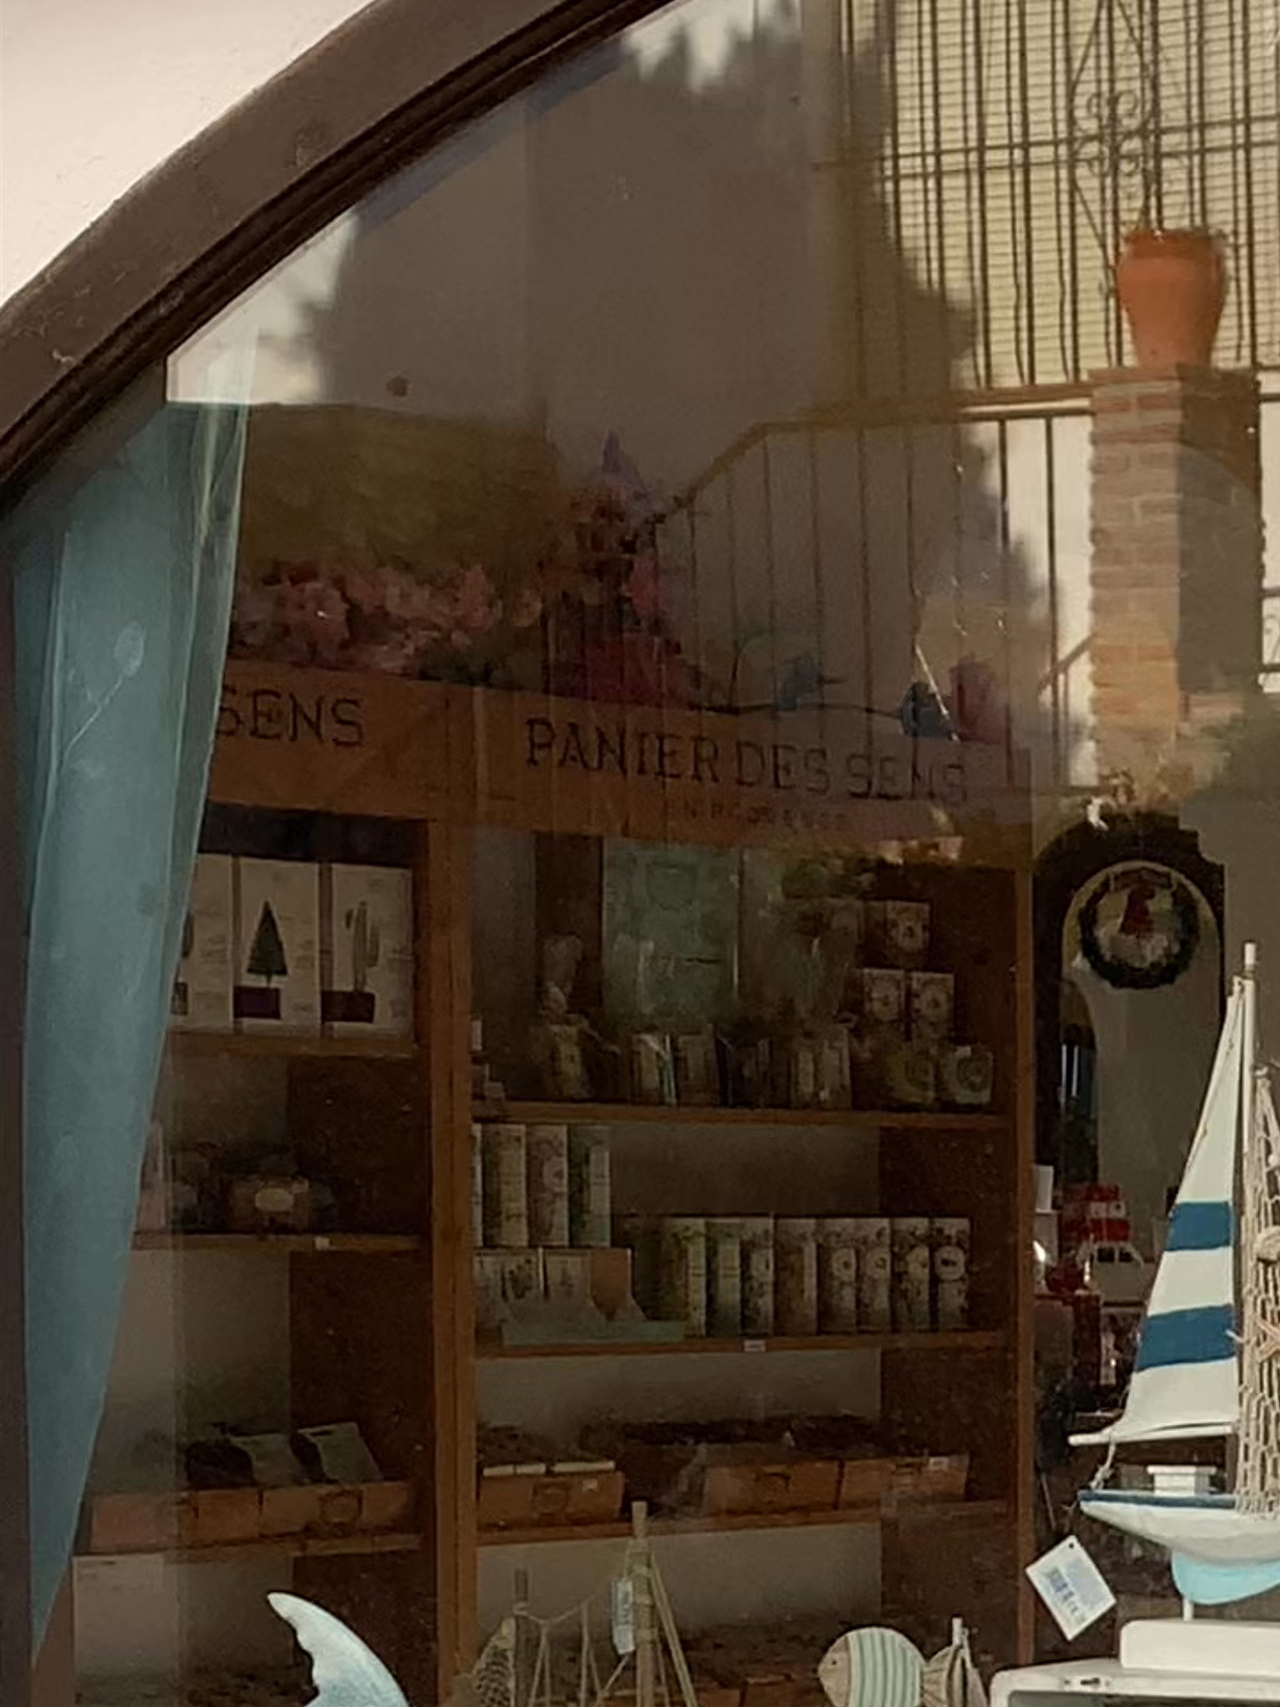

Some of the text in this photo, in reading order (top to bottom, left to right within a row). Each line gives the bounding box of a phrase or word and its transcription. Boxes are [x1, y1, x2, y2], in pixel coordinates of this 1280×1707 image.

[526, 717, 967, 808] PANIER DES SENS
